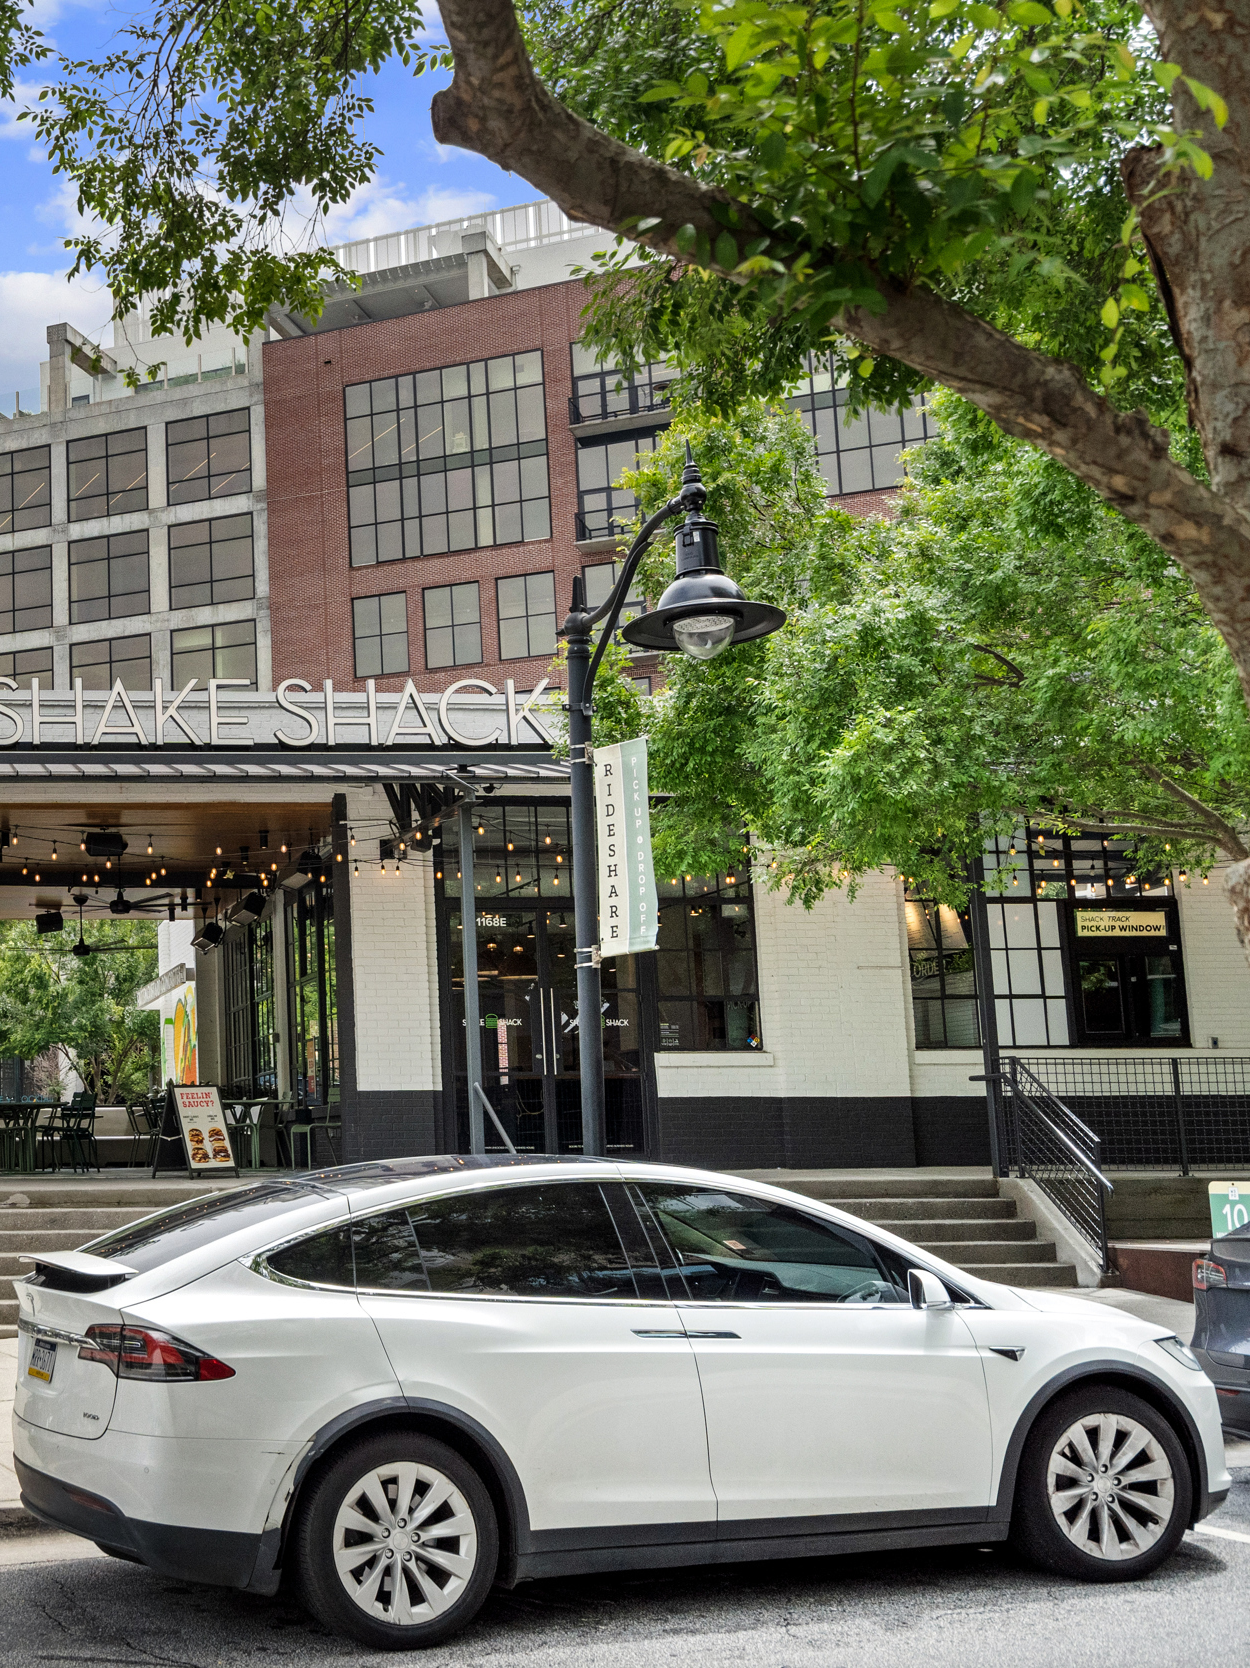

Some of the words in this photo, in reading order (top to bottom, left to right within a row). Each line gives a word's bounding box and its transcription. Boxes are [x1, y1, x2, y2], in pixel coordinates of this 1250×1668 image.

[274, 676, 554, 747] SHACK
[604, 763, 619, 938] RIDESHARE
[475, 917, 507, 927] 1168E
[1081, 924, 1116, 932] PICK-UP
[1118, 924, 1162, 932] WINDOW
[605, 1018, 629, 1026] SHACK
[182, 1100, 214, 1108] SAUCY?
[1222, 1203, 1249, 1230] 10
